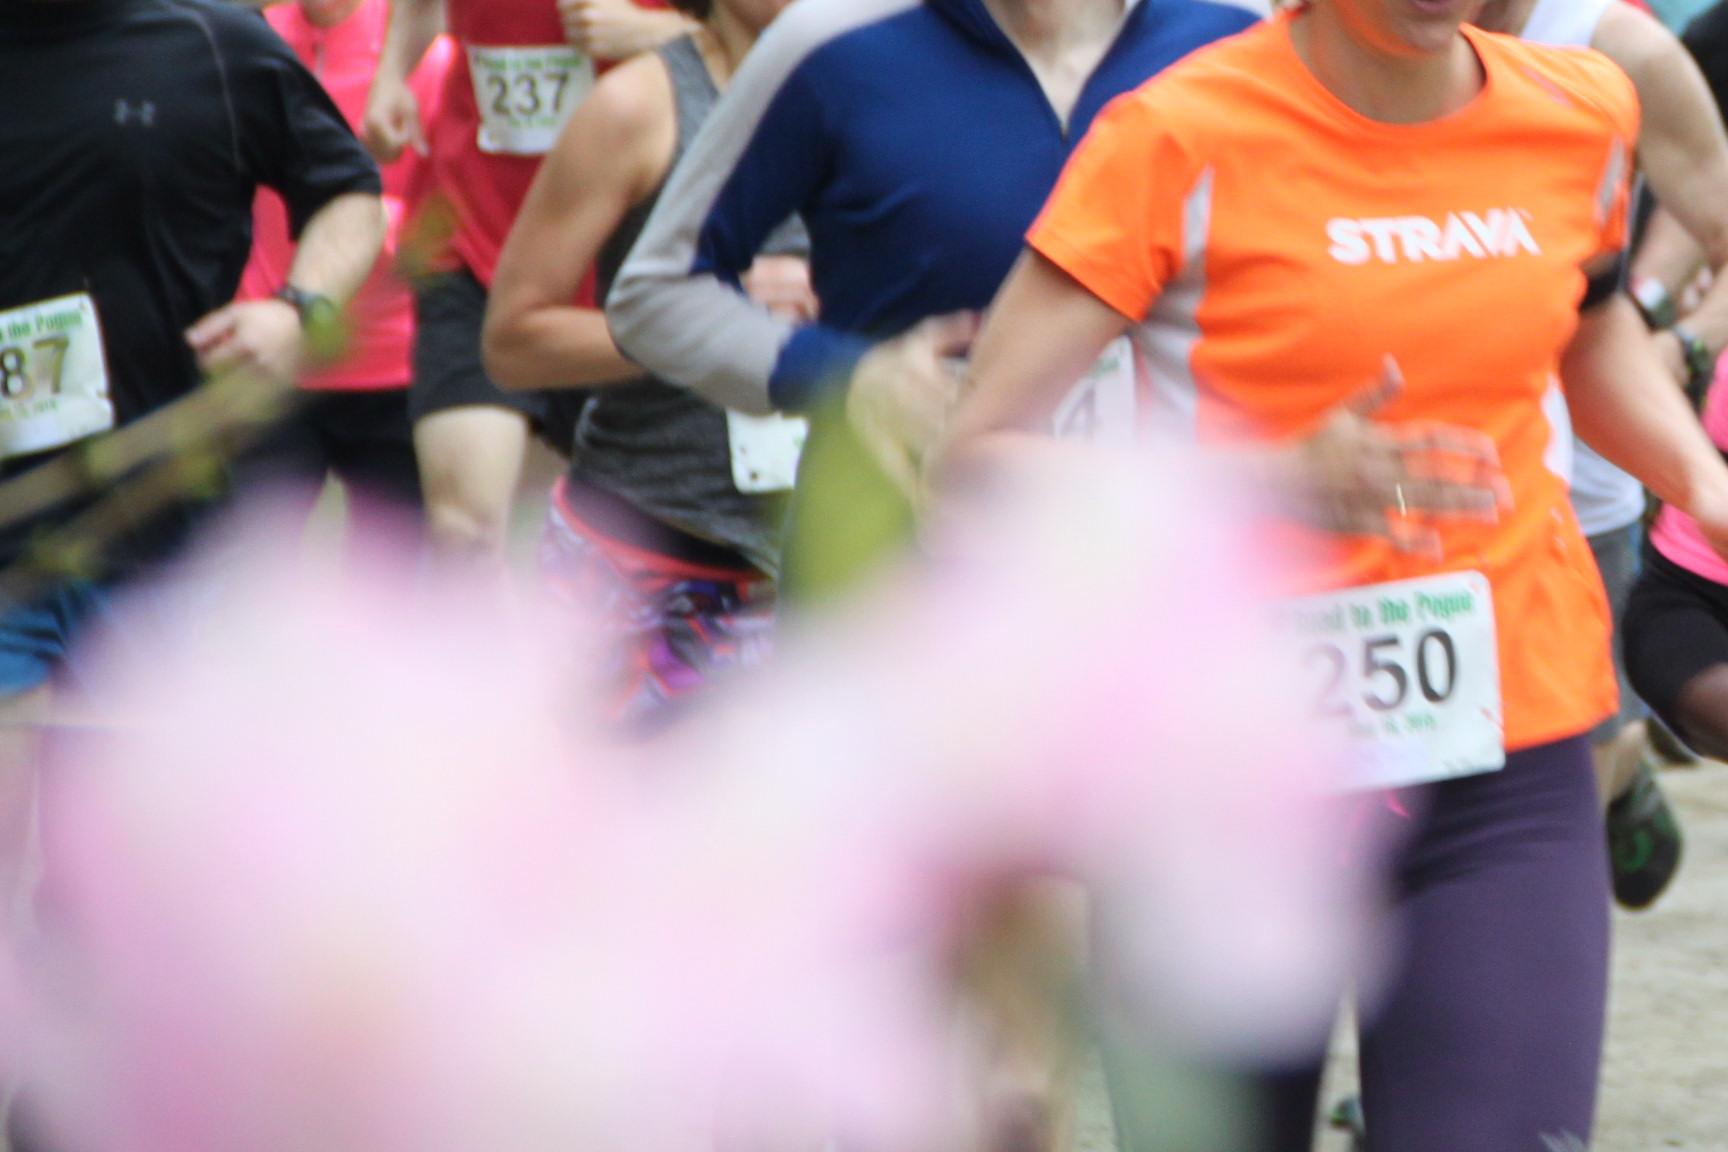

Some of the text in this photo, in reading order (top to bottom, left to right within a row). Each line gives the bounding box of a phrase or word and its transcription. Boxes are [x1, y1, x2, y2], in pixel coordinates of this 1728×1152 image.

[488, 71, 569, 115] 237
[1326, 206, 1542, 264] STRAVA
[1302, 627, 1457, 717] 250
